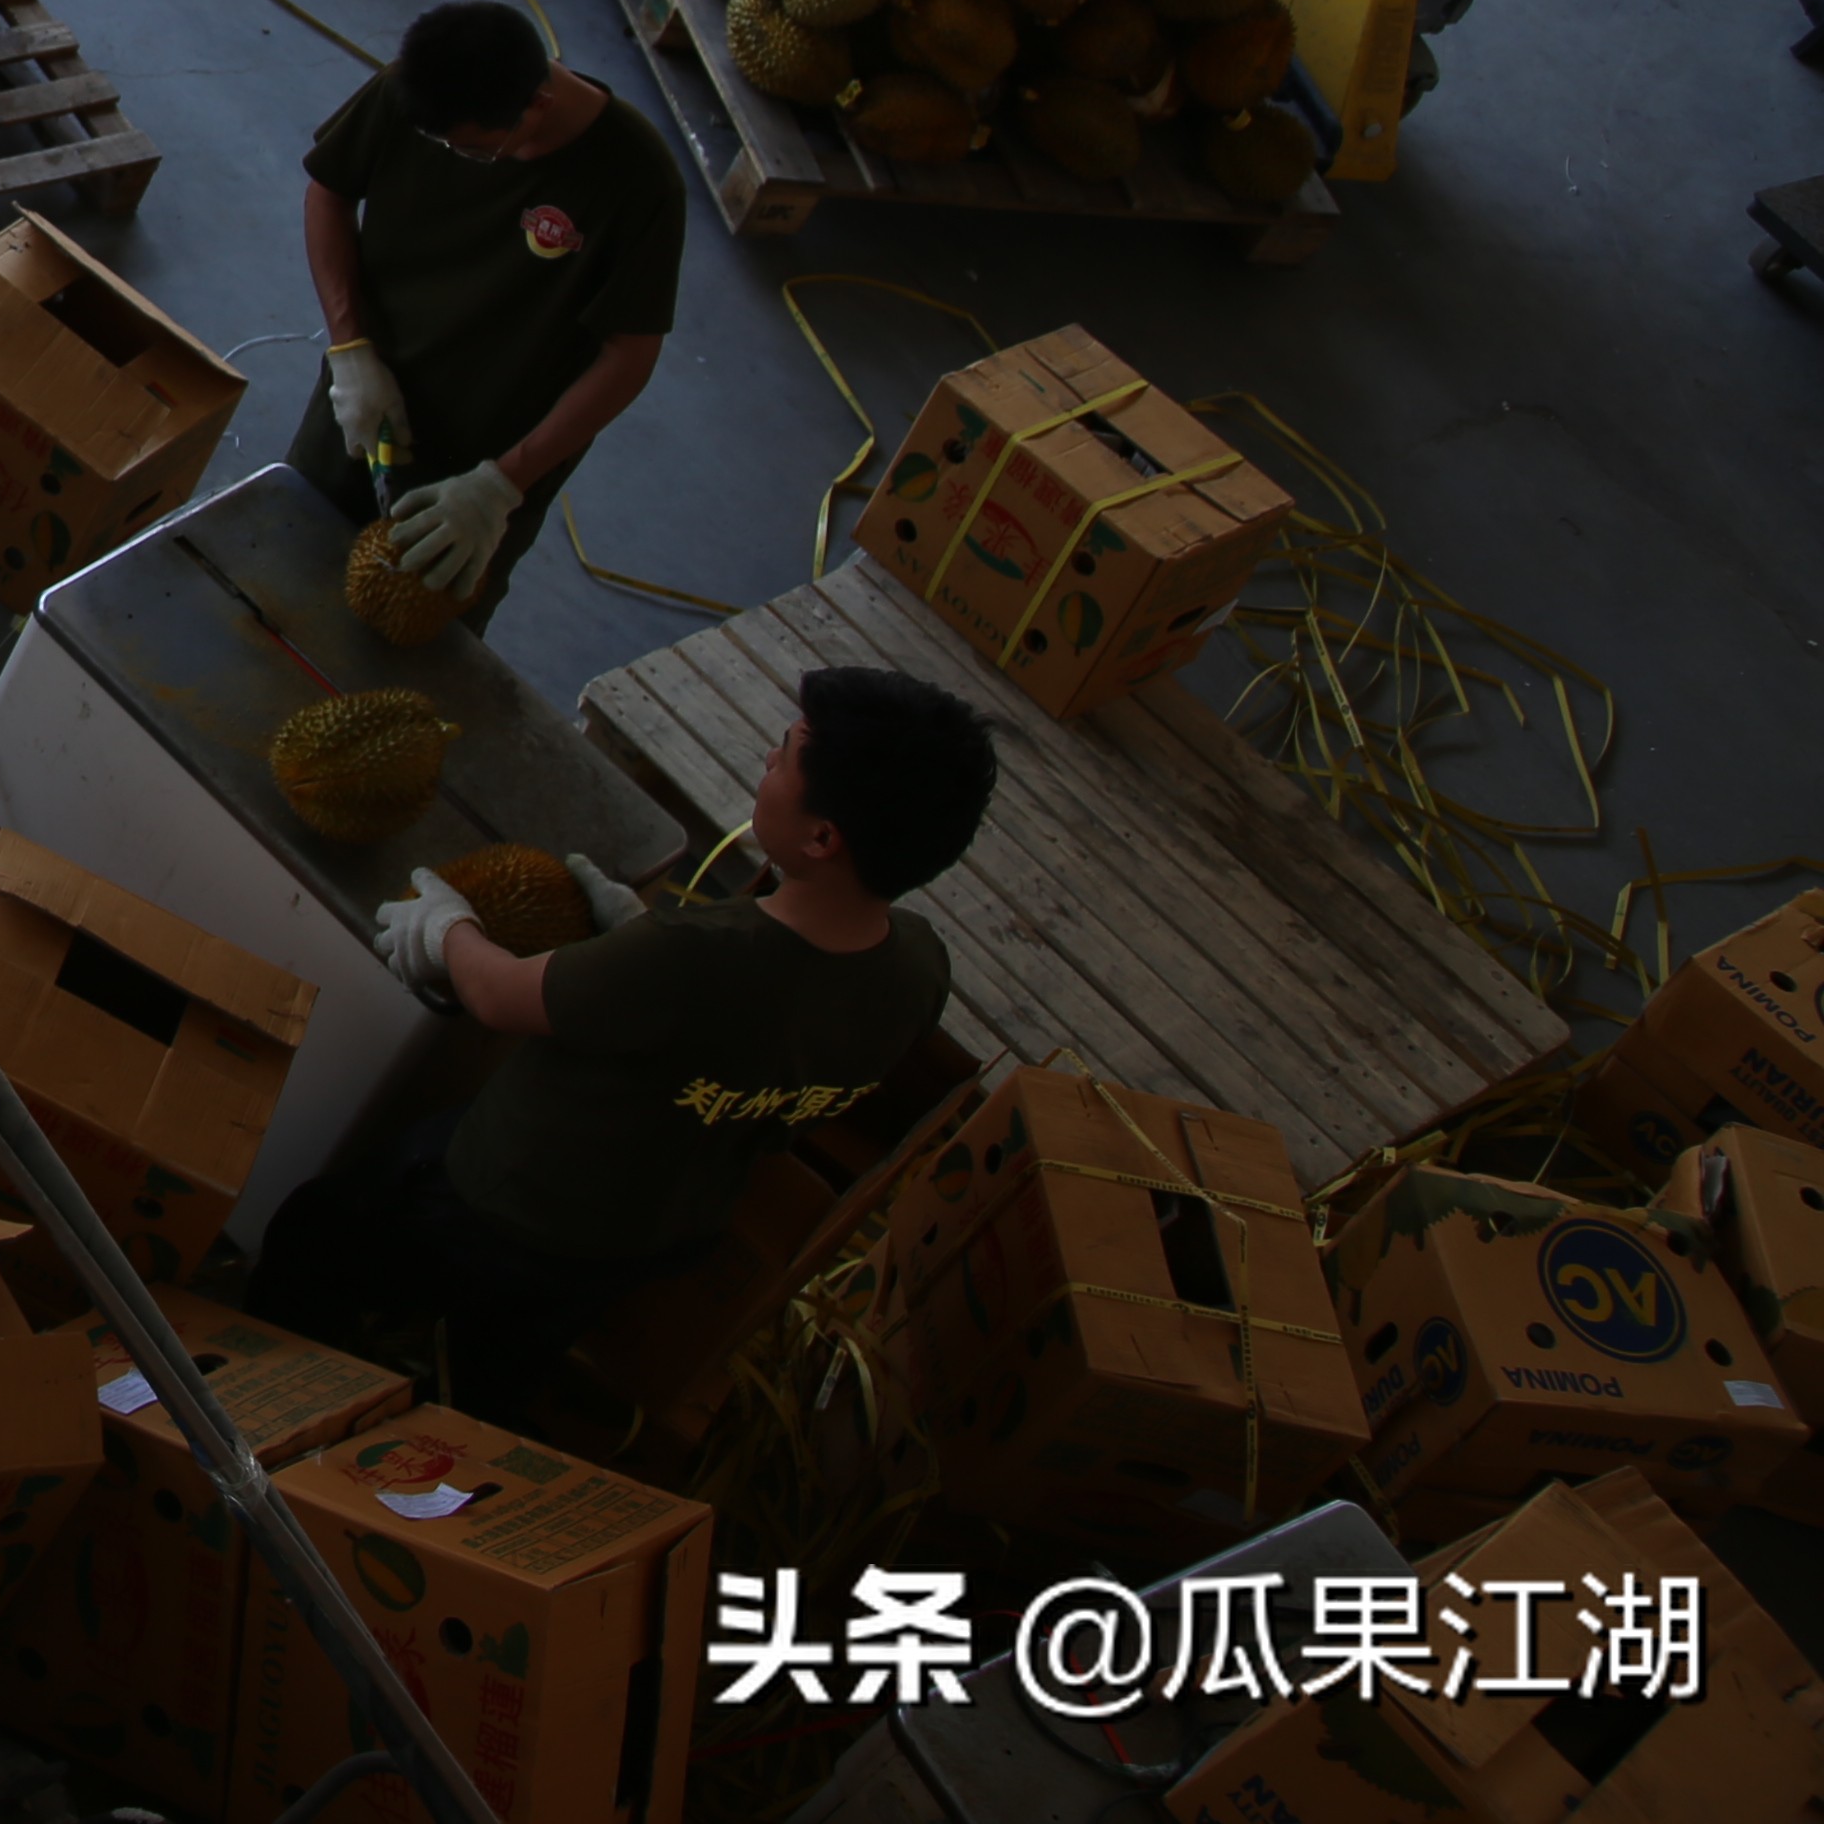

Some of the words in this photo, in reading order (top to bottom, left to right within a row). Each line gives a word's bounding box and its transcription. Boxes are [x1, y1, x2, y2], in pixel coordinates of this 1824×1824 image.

[1716, 956, 1817, 1044] POMINA
[1742, 1046, 1824, 1123] URIAN
[1556, 1262, 1658, 1328] AC
[1501, 1366, 1625, 1398] POMINA
[1528, 1428, 1654, 1455] POMINA
[474, 1673, 527, 1824] 選榴蓮
